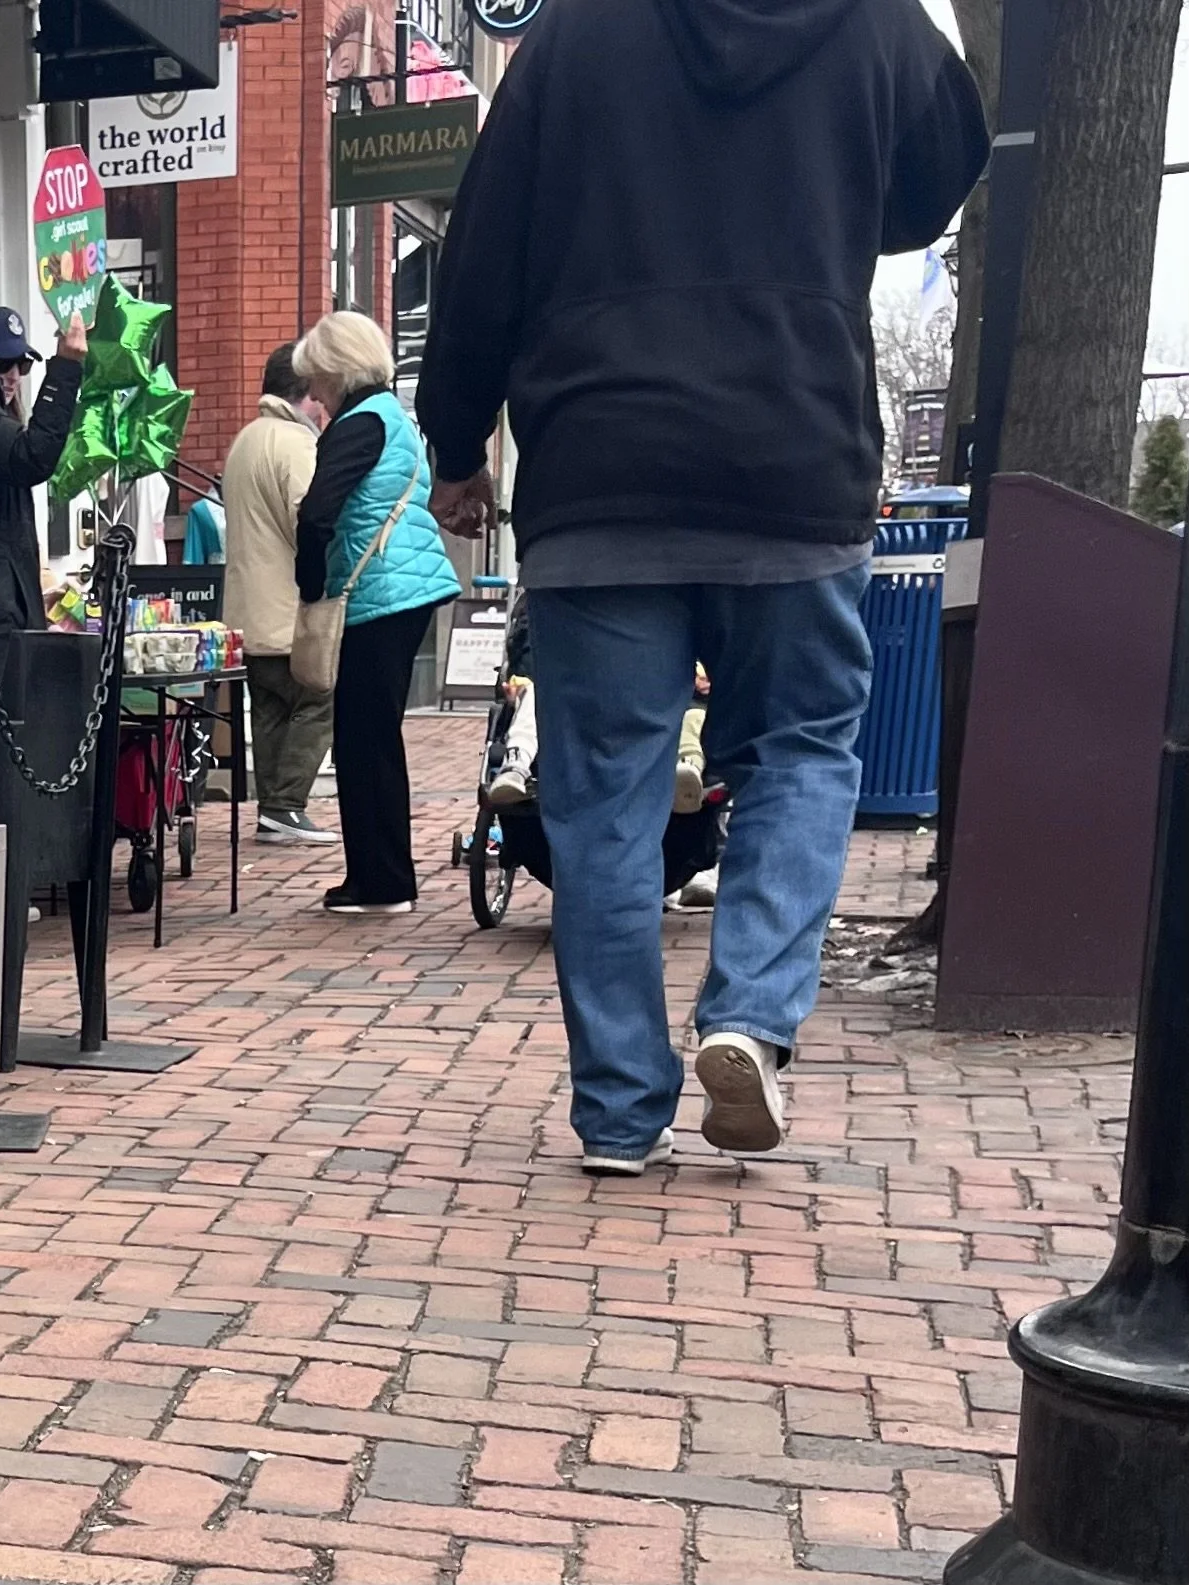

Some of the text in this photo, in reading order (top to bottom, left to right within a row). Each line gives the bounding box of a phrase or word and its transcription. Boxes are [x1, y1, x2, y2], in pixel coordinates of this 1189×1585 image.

[98, 115, 226, 150] the world
[339, 125, 469, 163] MARMARA
[98, 146, 193, 178] crafted
[45, 162, 88, 215] STOP
[51, 217, 89, 242] girl scout
[39, 238, 106, 291] cookies
[57, 285, 96, 319] for sale!
[171, 587, 183, 602] in
[186, 584, 215, 602] and
